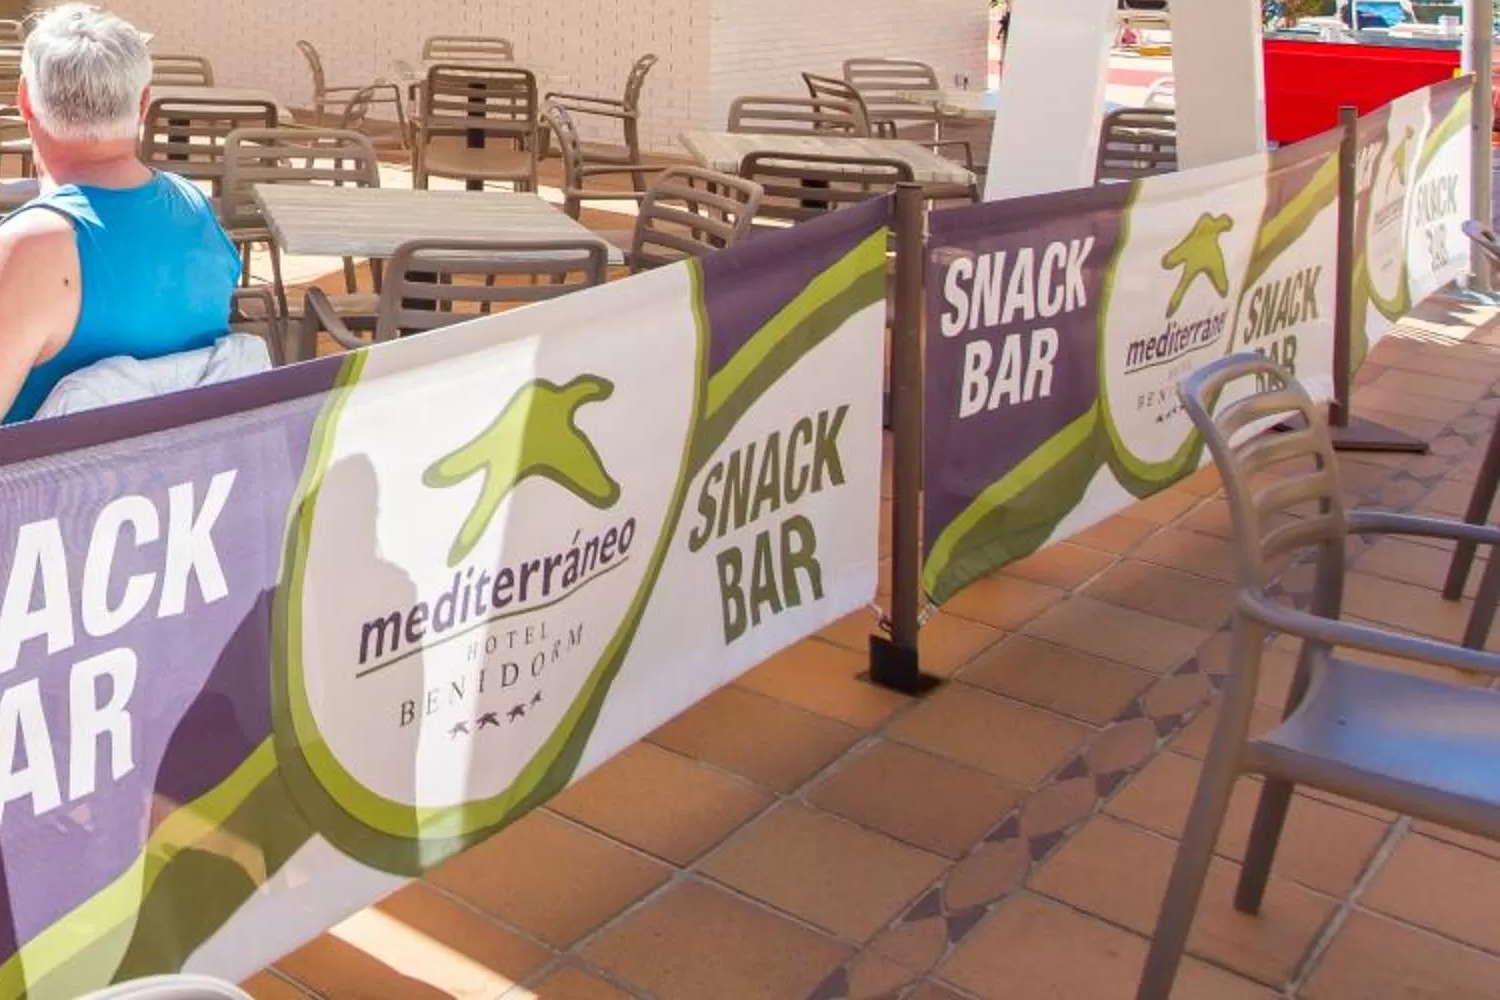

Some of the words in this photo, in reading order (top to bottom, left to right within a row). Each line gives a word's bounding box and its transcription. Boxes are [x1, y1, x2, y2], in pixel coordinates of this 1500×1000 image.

[940, 236, 1096, 338] SNACK
[1243, 264, 1323, 345] SNACK
[959, 327, 1060, 419] BAR
[688, 403, 851, 553] SNACK
[358, 516, 637, 666] mediterráneo
[716, 514, 825, 646] BAR
[399, 623, 584, 729] BENIDORM
[466, 621, 550, 663] HOTEL
